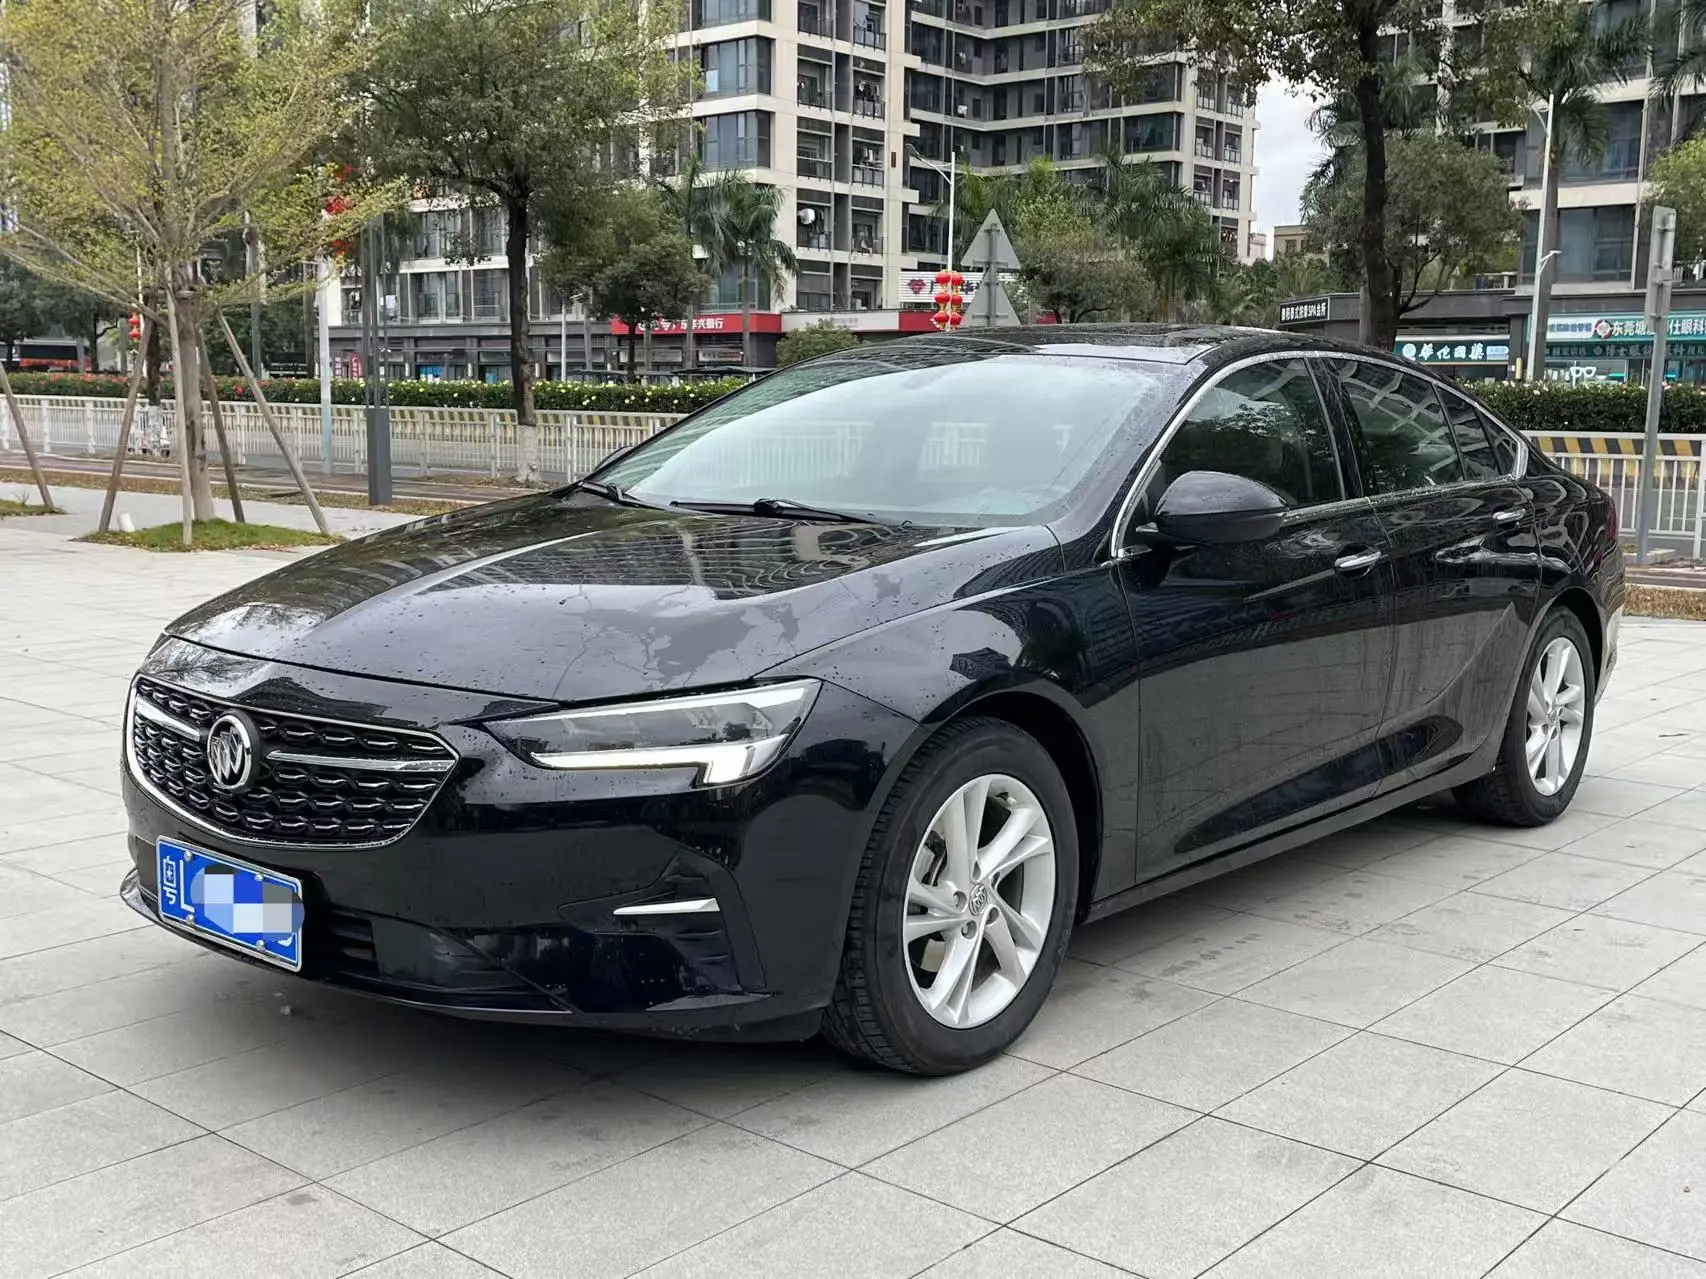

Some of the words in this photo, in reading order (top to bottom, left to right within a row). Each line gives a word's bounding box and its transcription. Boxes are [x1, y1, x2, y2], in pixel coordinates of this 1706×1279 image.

[1612, 318, 1706, 336] 东莞塘仕眼科
